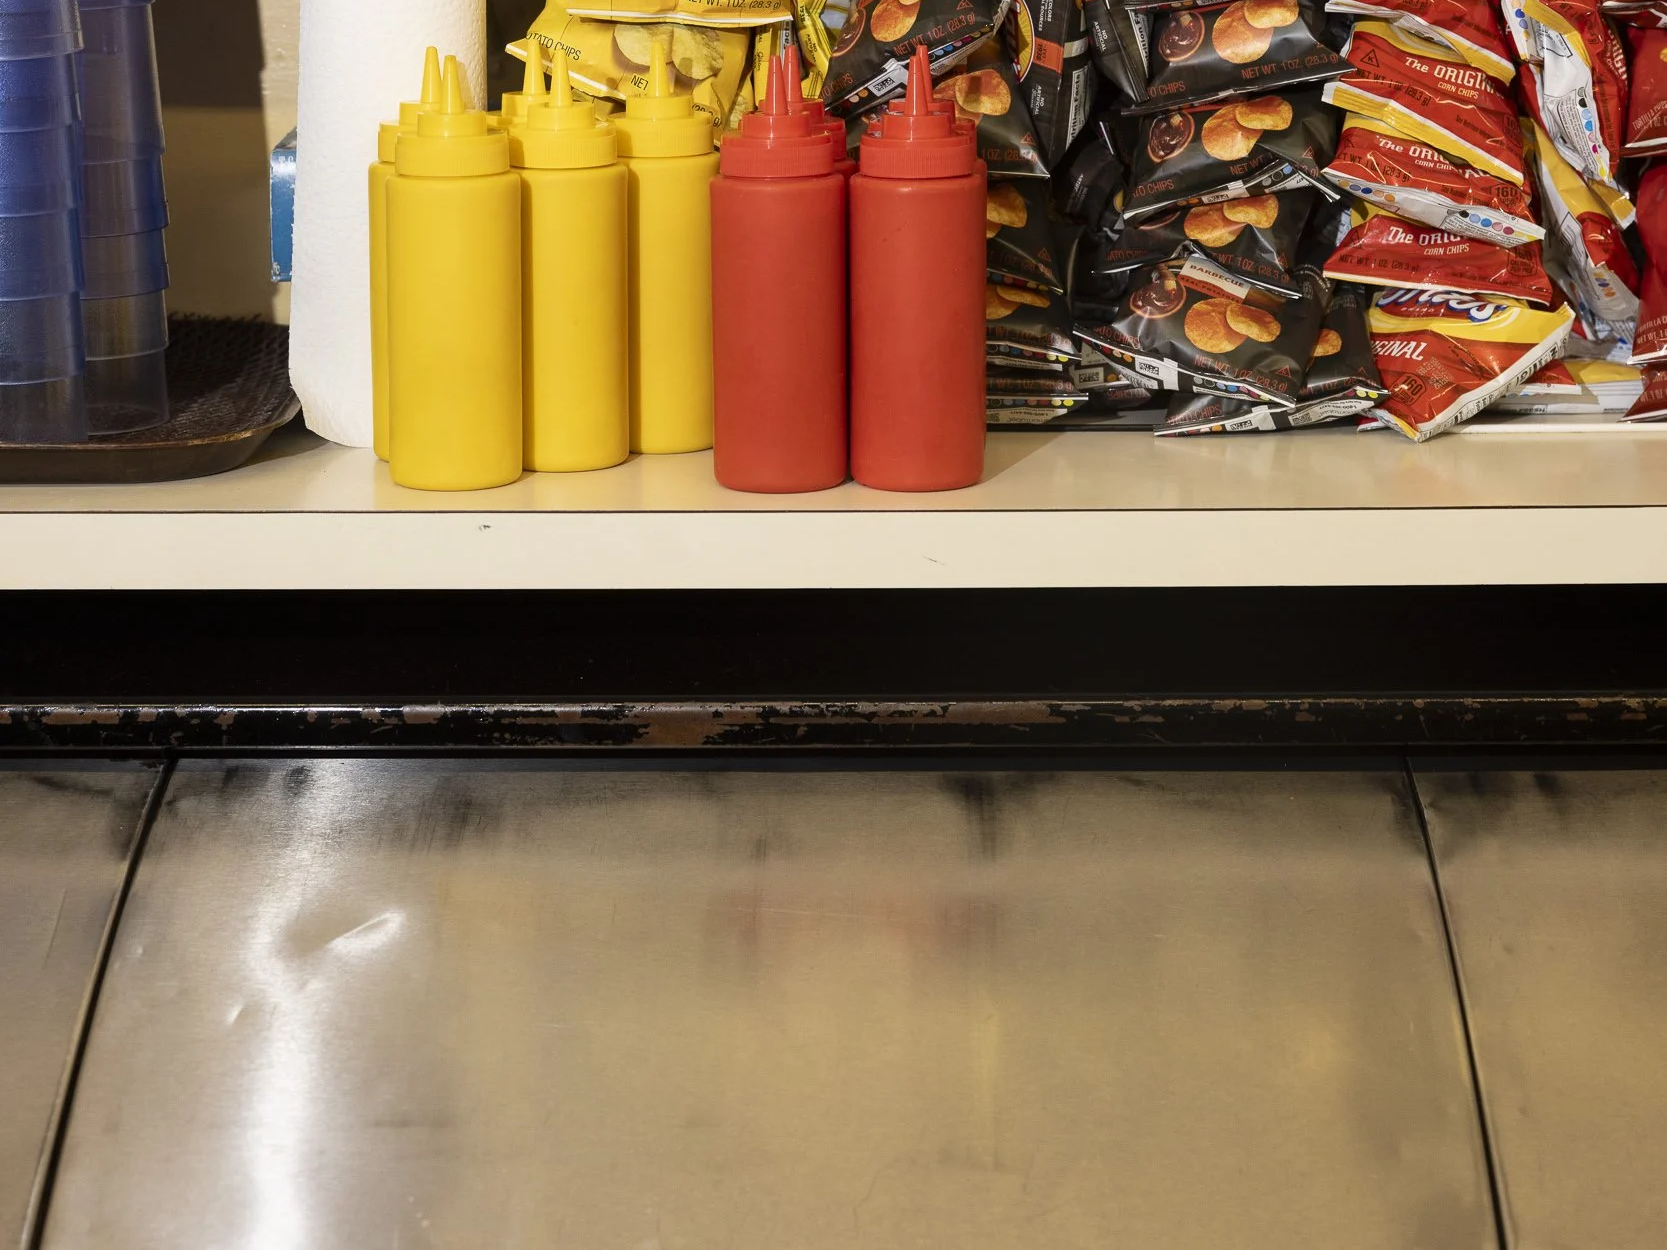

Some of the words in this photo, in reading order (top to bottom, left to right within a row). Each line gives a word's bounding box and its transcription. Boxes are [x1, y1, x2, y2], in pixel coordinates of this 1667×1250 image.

[749, 0, 771, 10] (28.3
[947, 16, 969, 34] (28.3
[1405, 56, 1429, 73] The
[1159, 81, 1186, 95] CHIPS
[1241, 66, 1260, 79] NET
[1438, 81, 1457, 95] CORN
[1457, 86, 1479, 100] CHIPS
[1380, 135, 1404, 153] The
[1149, 178, 1174, 195] CHIPS
[1230, 159, 1250, 175] NET
[1388, 226, 1414, 245] The
[1424, 245, 1445, 257] CORN
[1447, 243, 1470, 256] CHIPS
[1189, 264, 1246, 290] BARBECUE
[1400, 375, 1424, 396] 160
[1196, 404, 1222, 420] CHIPS
